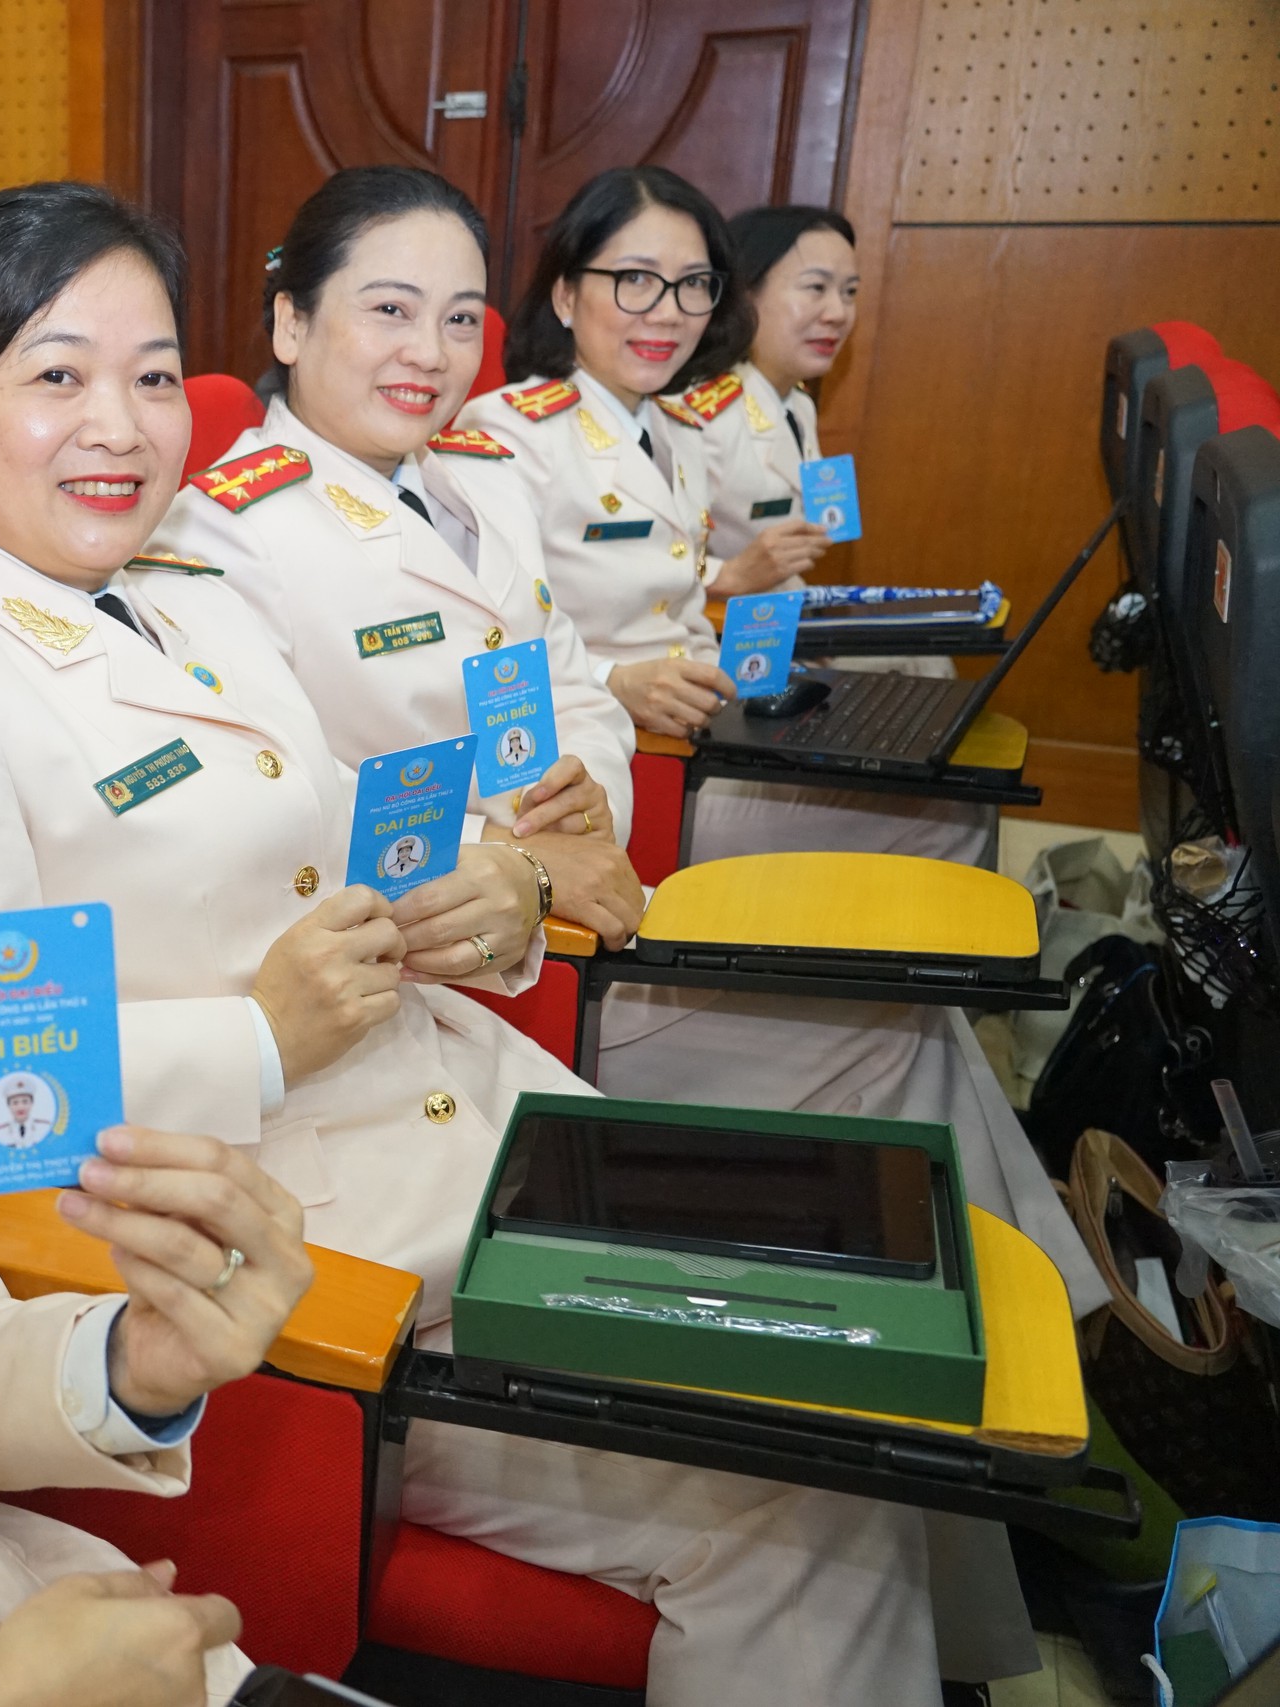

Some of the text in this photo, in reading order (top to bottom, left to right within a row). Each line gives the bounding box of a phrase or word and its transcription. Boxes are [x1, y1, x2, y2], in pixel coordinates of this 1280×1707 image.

[486, 710, 508, 727] ĐẠI
[510, 700, 537, 720] BIỂU
[374, 818, 404, 836] ĐẠI
[407, 804, 445, 828] BIỂU
[13, 1023, 78, 1057] BIỂU
